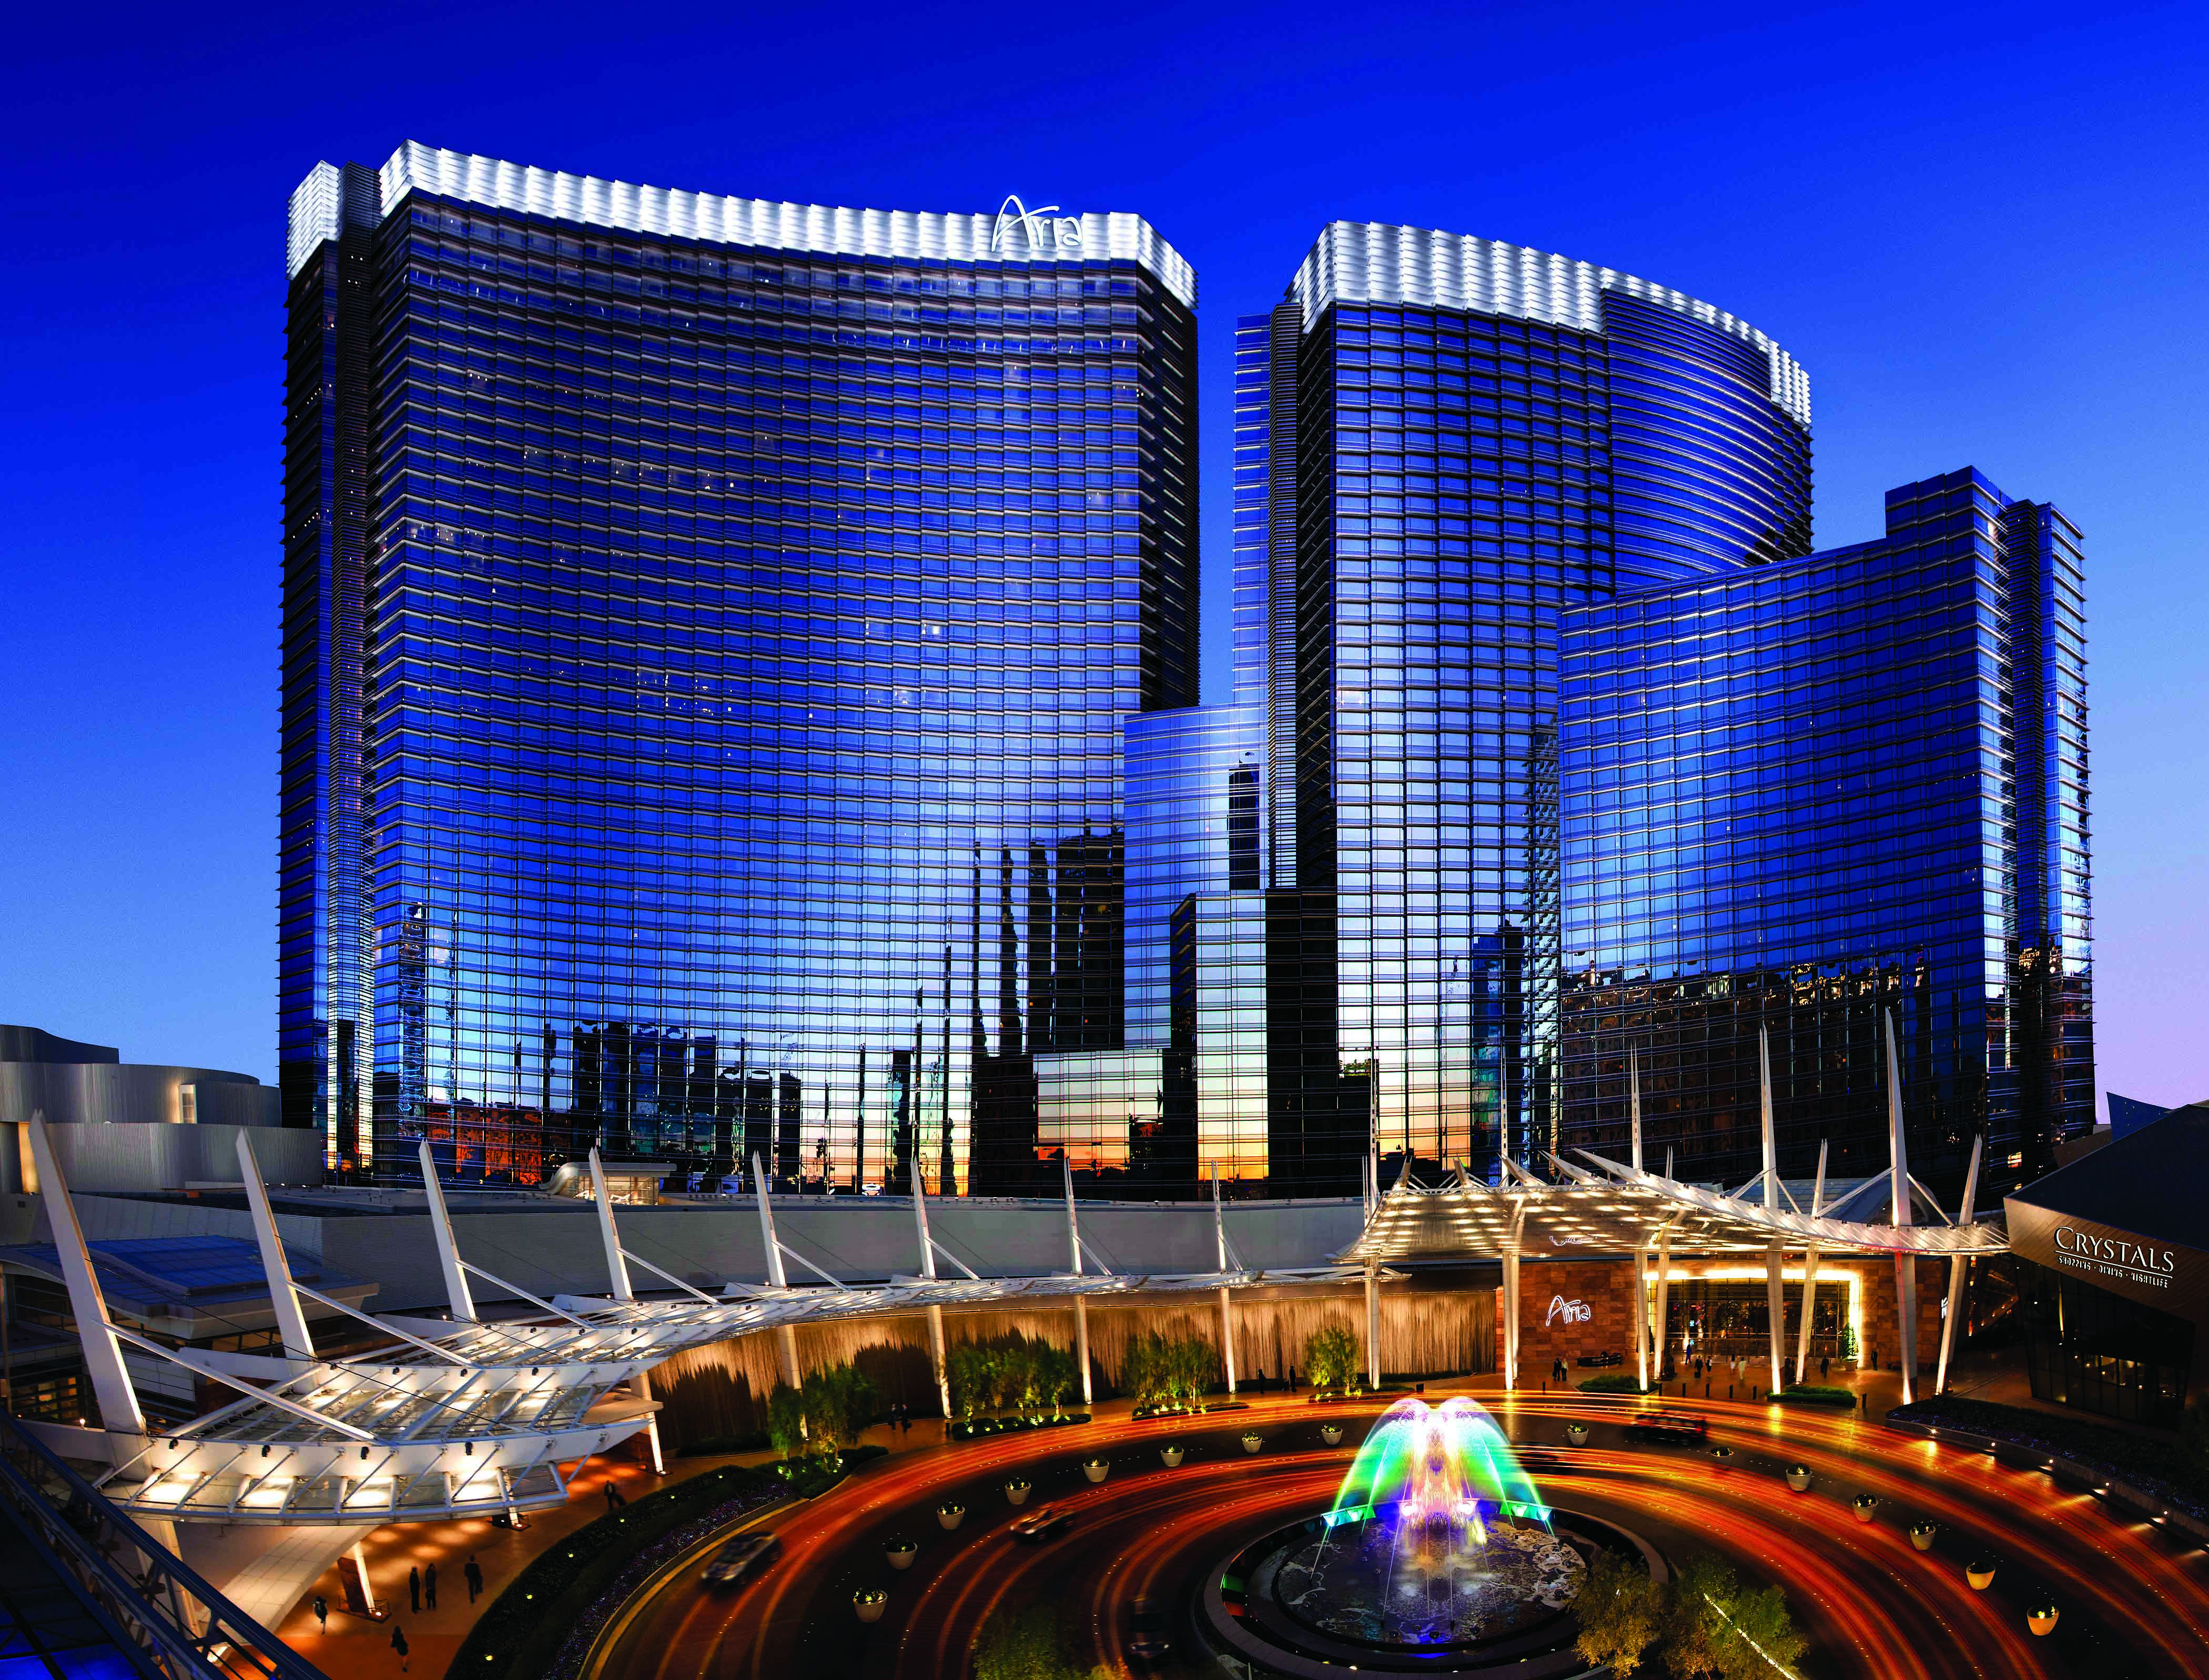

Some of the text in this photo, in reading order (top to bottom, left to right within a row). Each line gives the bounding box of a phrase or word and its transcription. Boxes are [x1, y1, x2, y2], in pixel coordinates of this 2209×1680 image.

[991, 195, 1083, 252] Aria
[2055, 1227, 2174, 1272] CRYSTALS
[2059, 1256, 2168, 1288] SHOPPING DINING NIGHTLIFE
[1546, 1295, 1591, 1327] Aria
